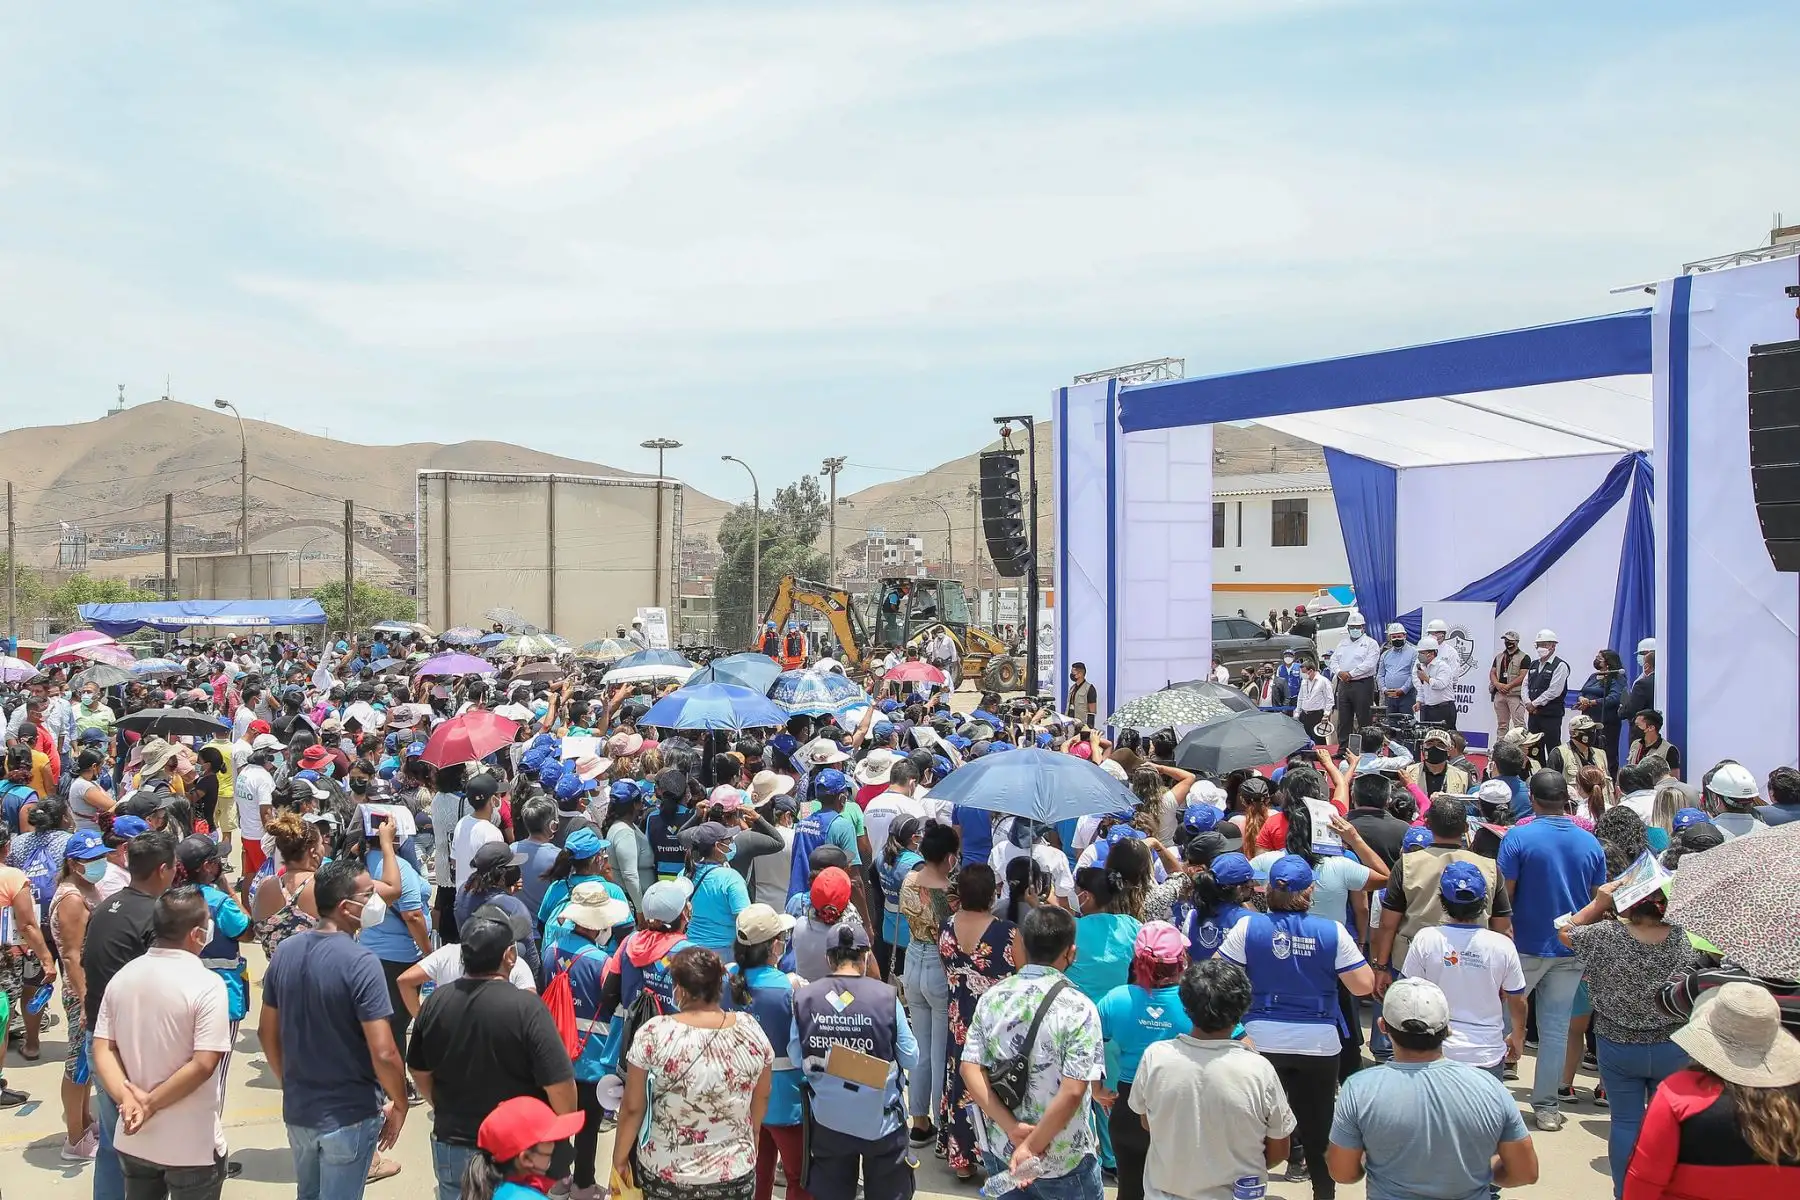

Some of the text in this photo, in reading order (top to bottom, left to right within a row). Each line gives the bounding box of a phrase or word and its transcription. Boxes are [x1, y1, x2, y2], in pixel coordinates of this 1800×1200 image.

[828, 599, 840, 610] CAT
[1453, 684, 1476, 694] ERNO
[1292, 949, 1312, 957] CALLAO
[810, 1012, 873, 1026] Ventanilla
[1138, 1019, 1173, 1028] Ventanilla
[809, 1035, 874, 1051] SERENAZGO
